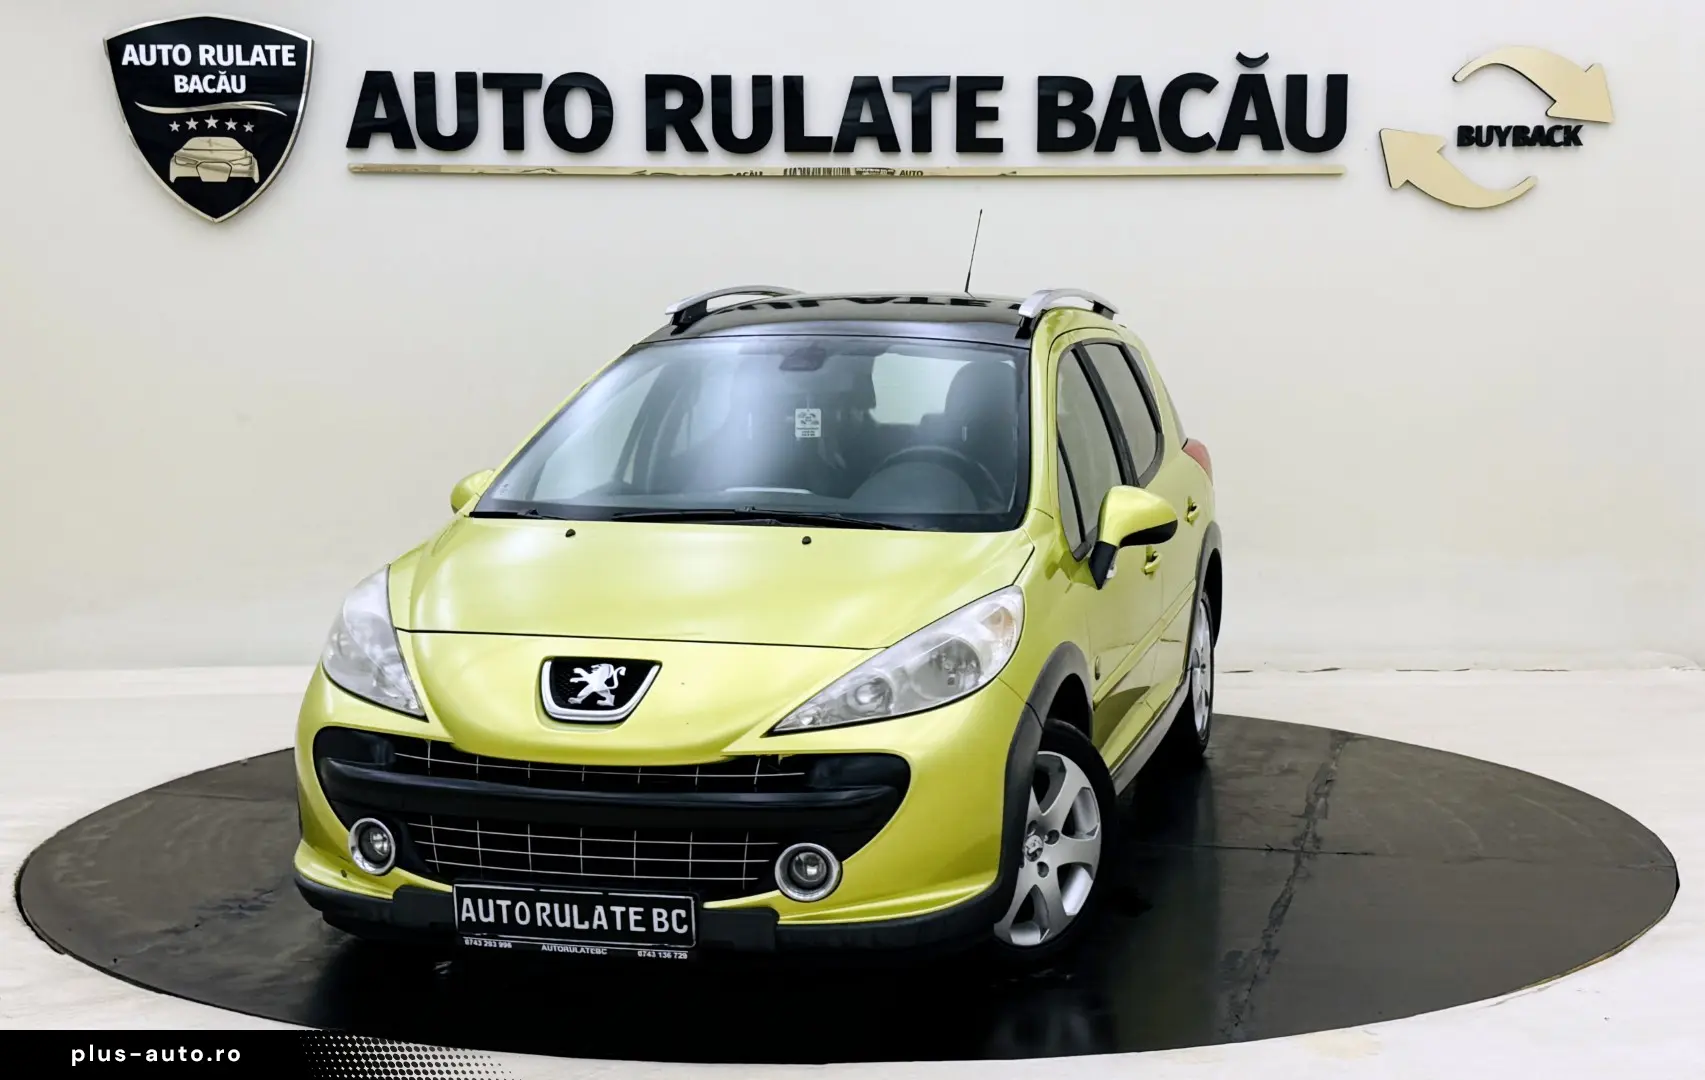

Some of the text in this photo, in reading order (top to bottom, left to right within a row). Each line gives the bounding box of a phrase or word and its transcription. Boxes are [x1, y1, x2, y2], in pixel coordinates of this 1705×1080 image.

[121, 44, 297, 66] AUTO RULATE
[173, 70, 247, 94] BACĂU
[346, 52, 1349, 154] AUTO RULATE BACĂU
[1456, 124, 1584, 147] BUYBACK
[652, 907, 690, 934] BC
